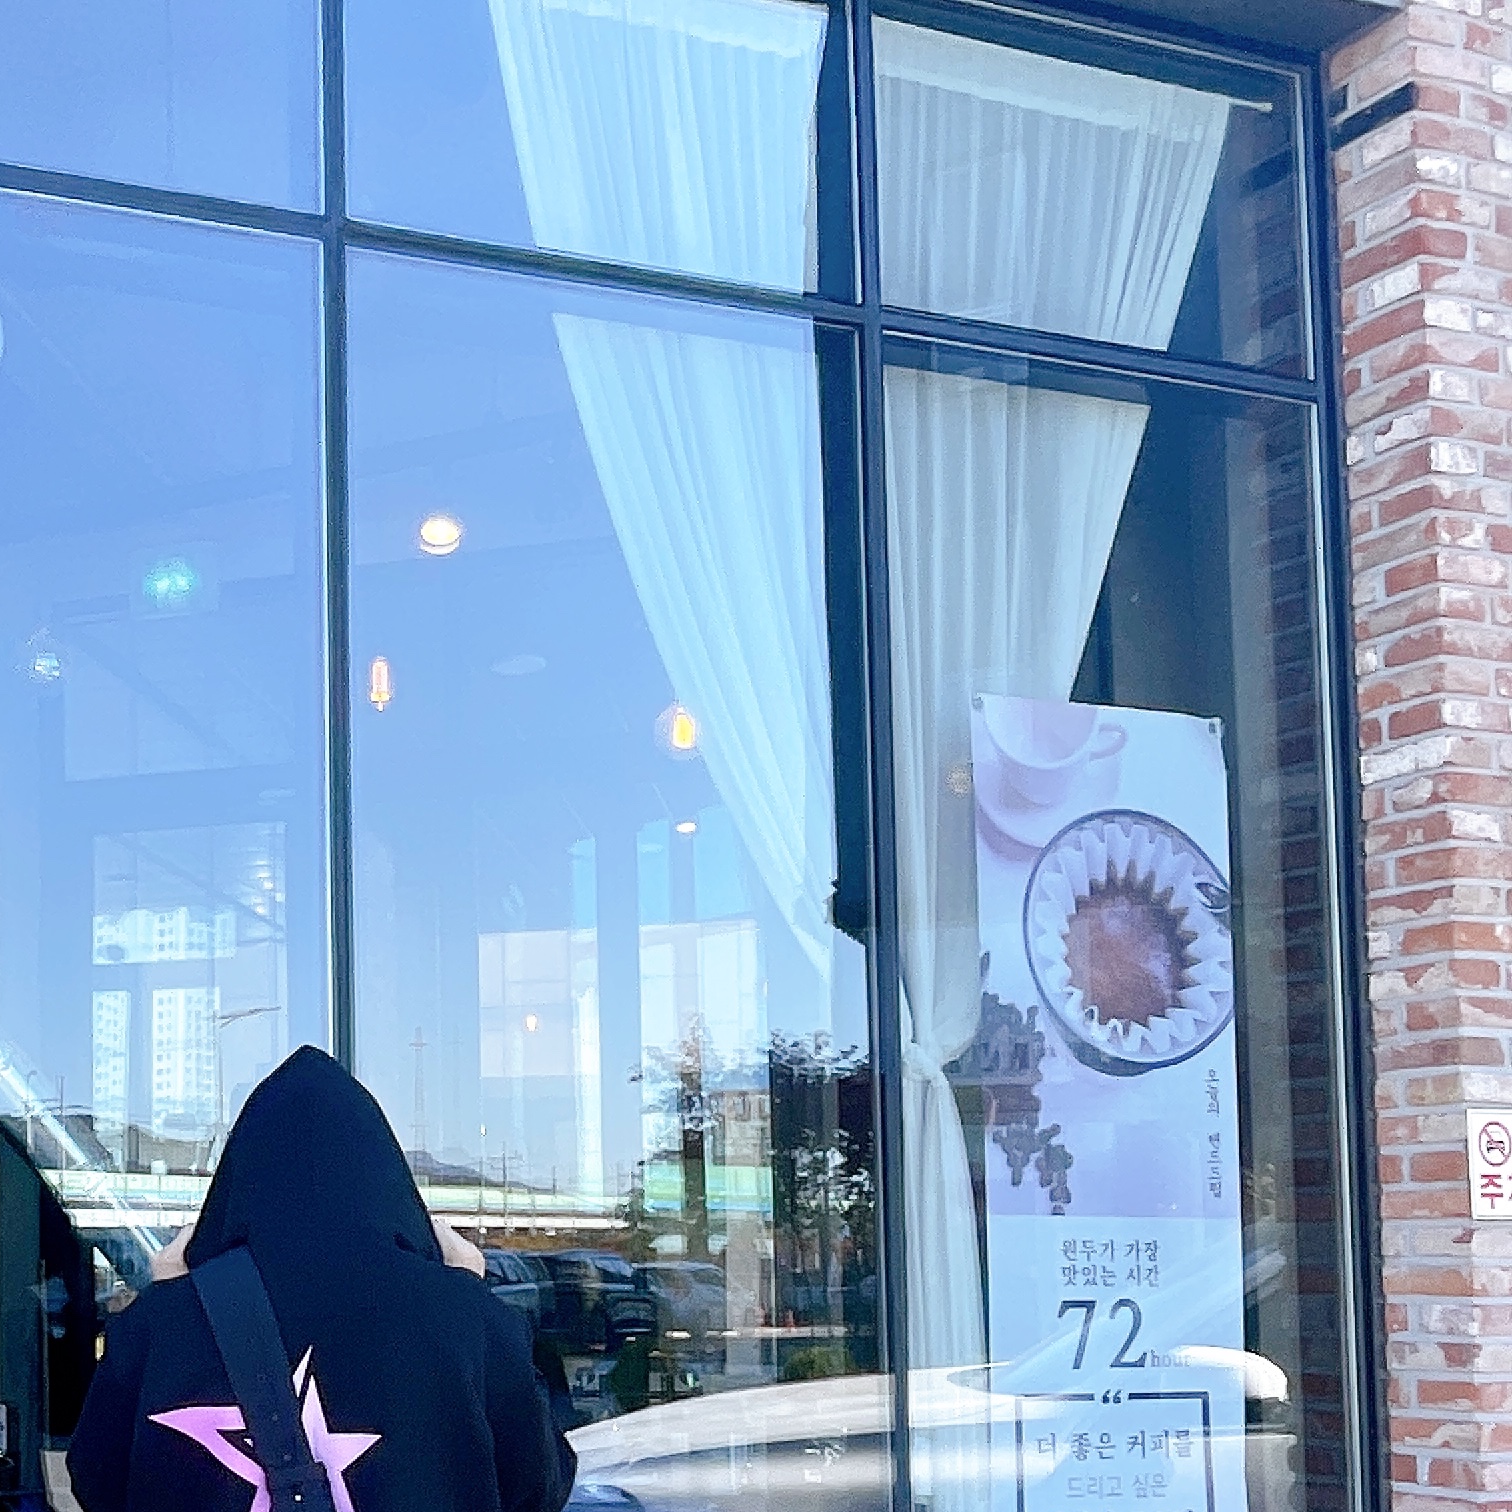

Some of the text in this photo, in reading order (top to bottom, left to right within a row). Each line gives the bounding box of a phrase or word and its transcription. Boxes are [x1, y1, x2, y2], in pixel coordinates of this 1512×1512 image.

[1060, 1239, 1161, 1262] 원두가 가장
[1060, 1264, 1160, 1288] 맛있는 시간
[1057, 1298, 1148, 1369] 72
[1037, 1429, 1194, 1461] 더 좋은 커피를
[1066, 1472, 1169, 1499] 드리고 싶은
